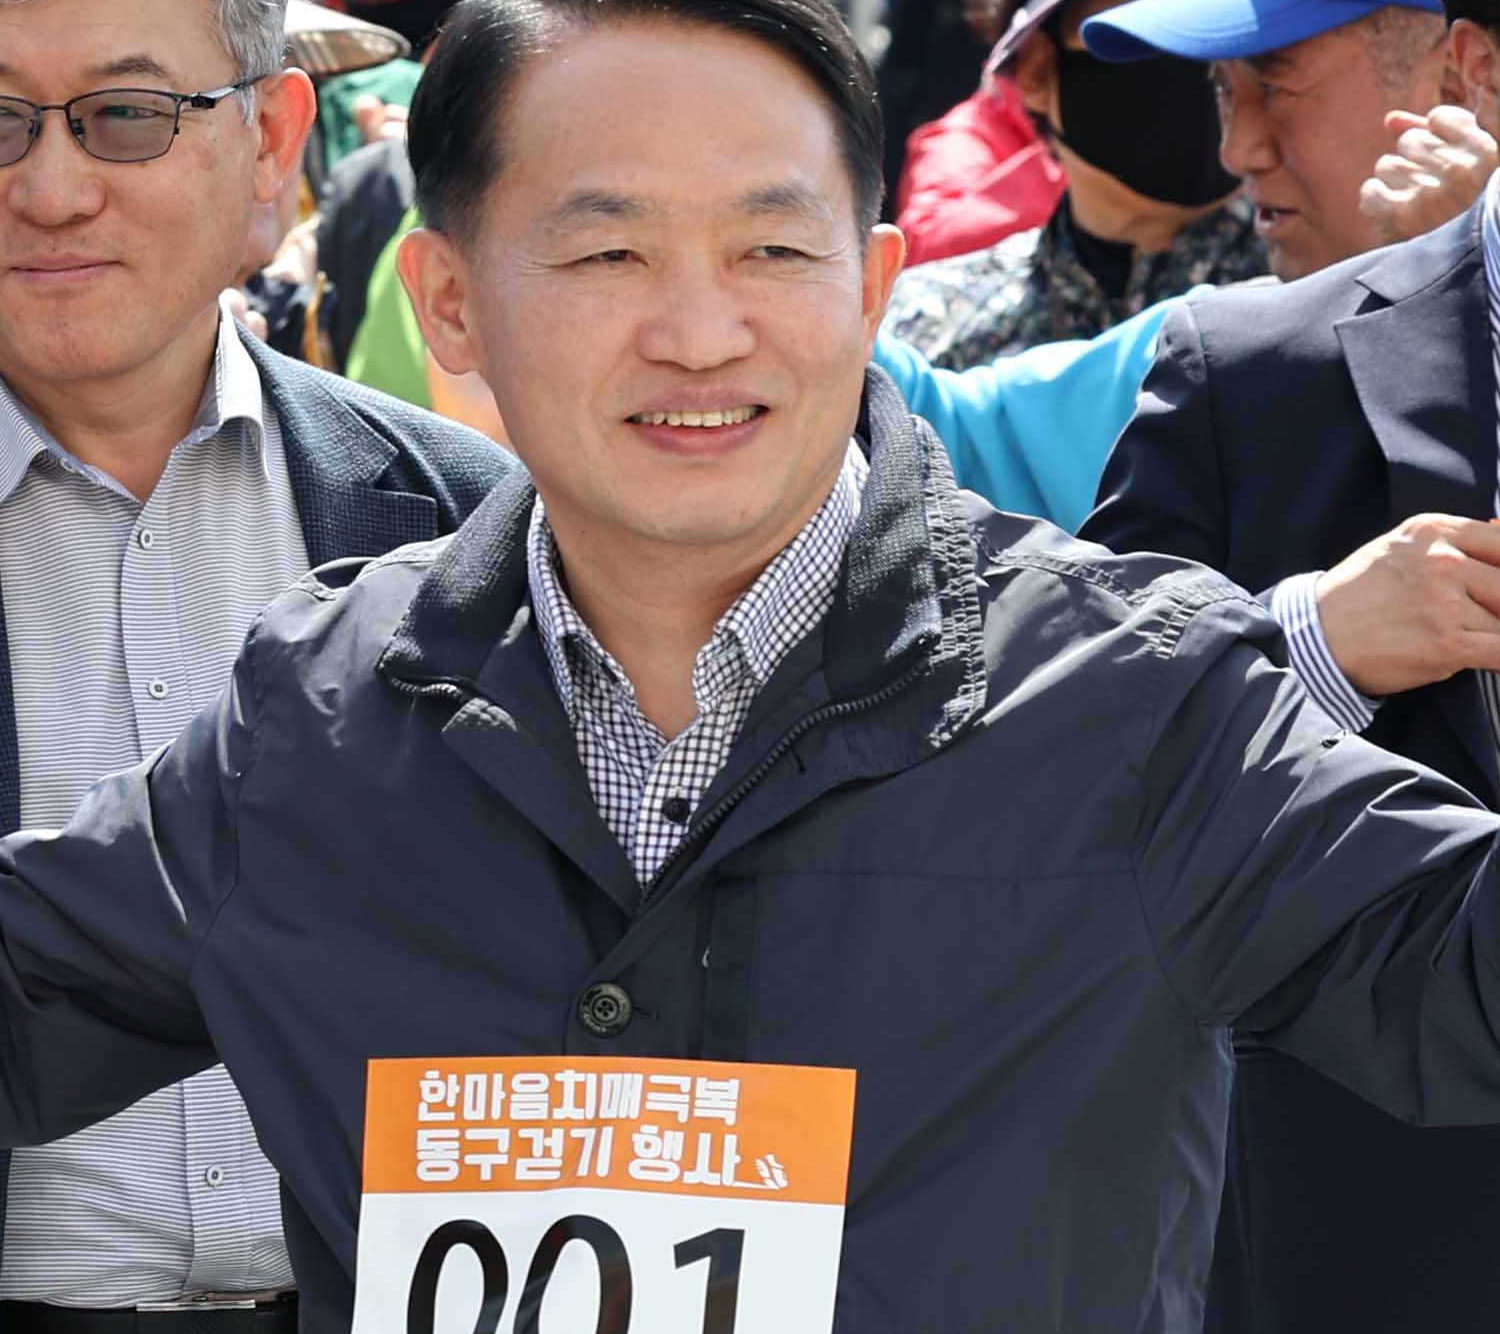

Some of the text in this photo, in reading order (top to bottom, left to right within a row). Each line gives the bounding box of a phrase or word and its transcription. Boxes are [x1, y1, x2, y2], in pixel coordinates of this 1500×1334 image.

[417, 1070, 740, 1125] 한마음치매극복
[416, 1124, 741, 1186] 동구걷기 행사
